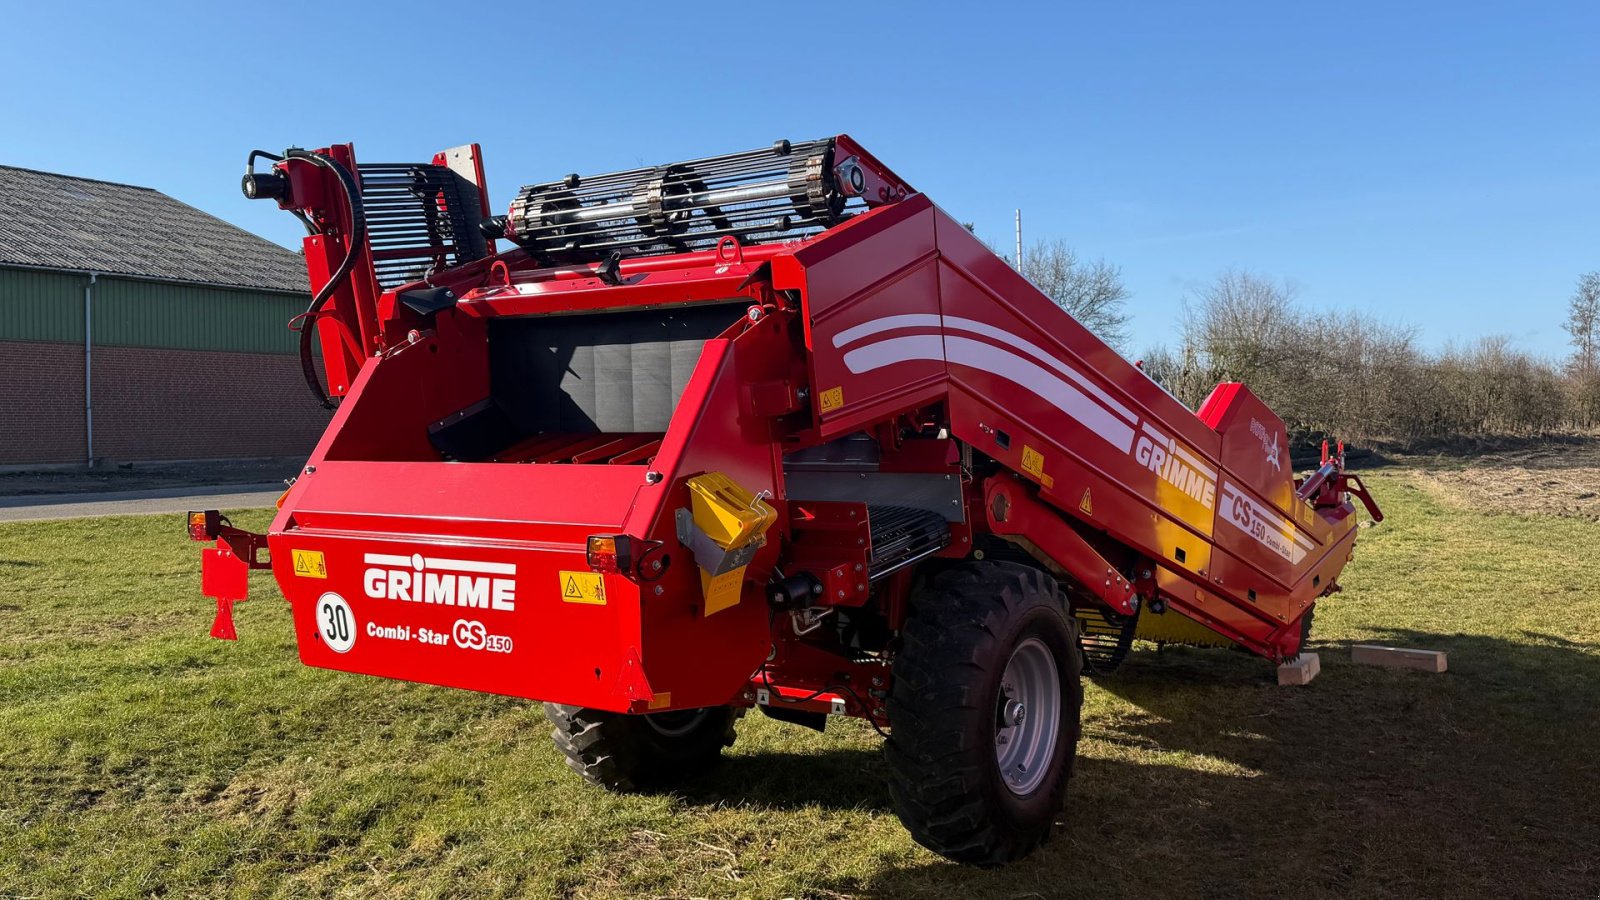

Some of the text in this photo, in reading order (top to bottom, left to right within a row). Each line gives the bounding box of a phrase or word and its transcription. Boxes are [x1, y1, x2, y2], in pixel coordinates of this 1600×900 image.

[1232, 495, 1252, 528] CS
[1250, 519, 1266, 541] 150
[323, 603, 349, 642] 30
[453, 619, 486, 649] CS
[487, 635, 512, 652] 150
